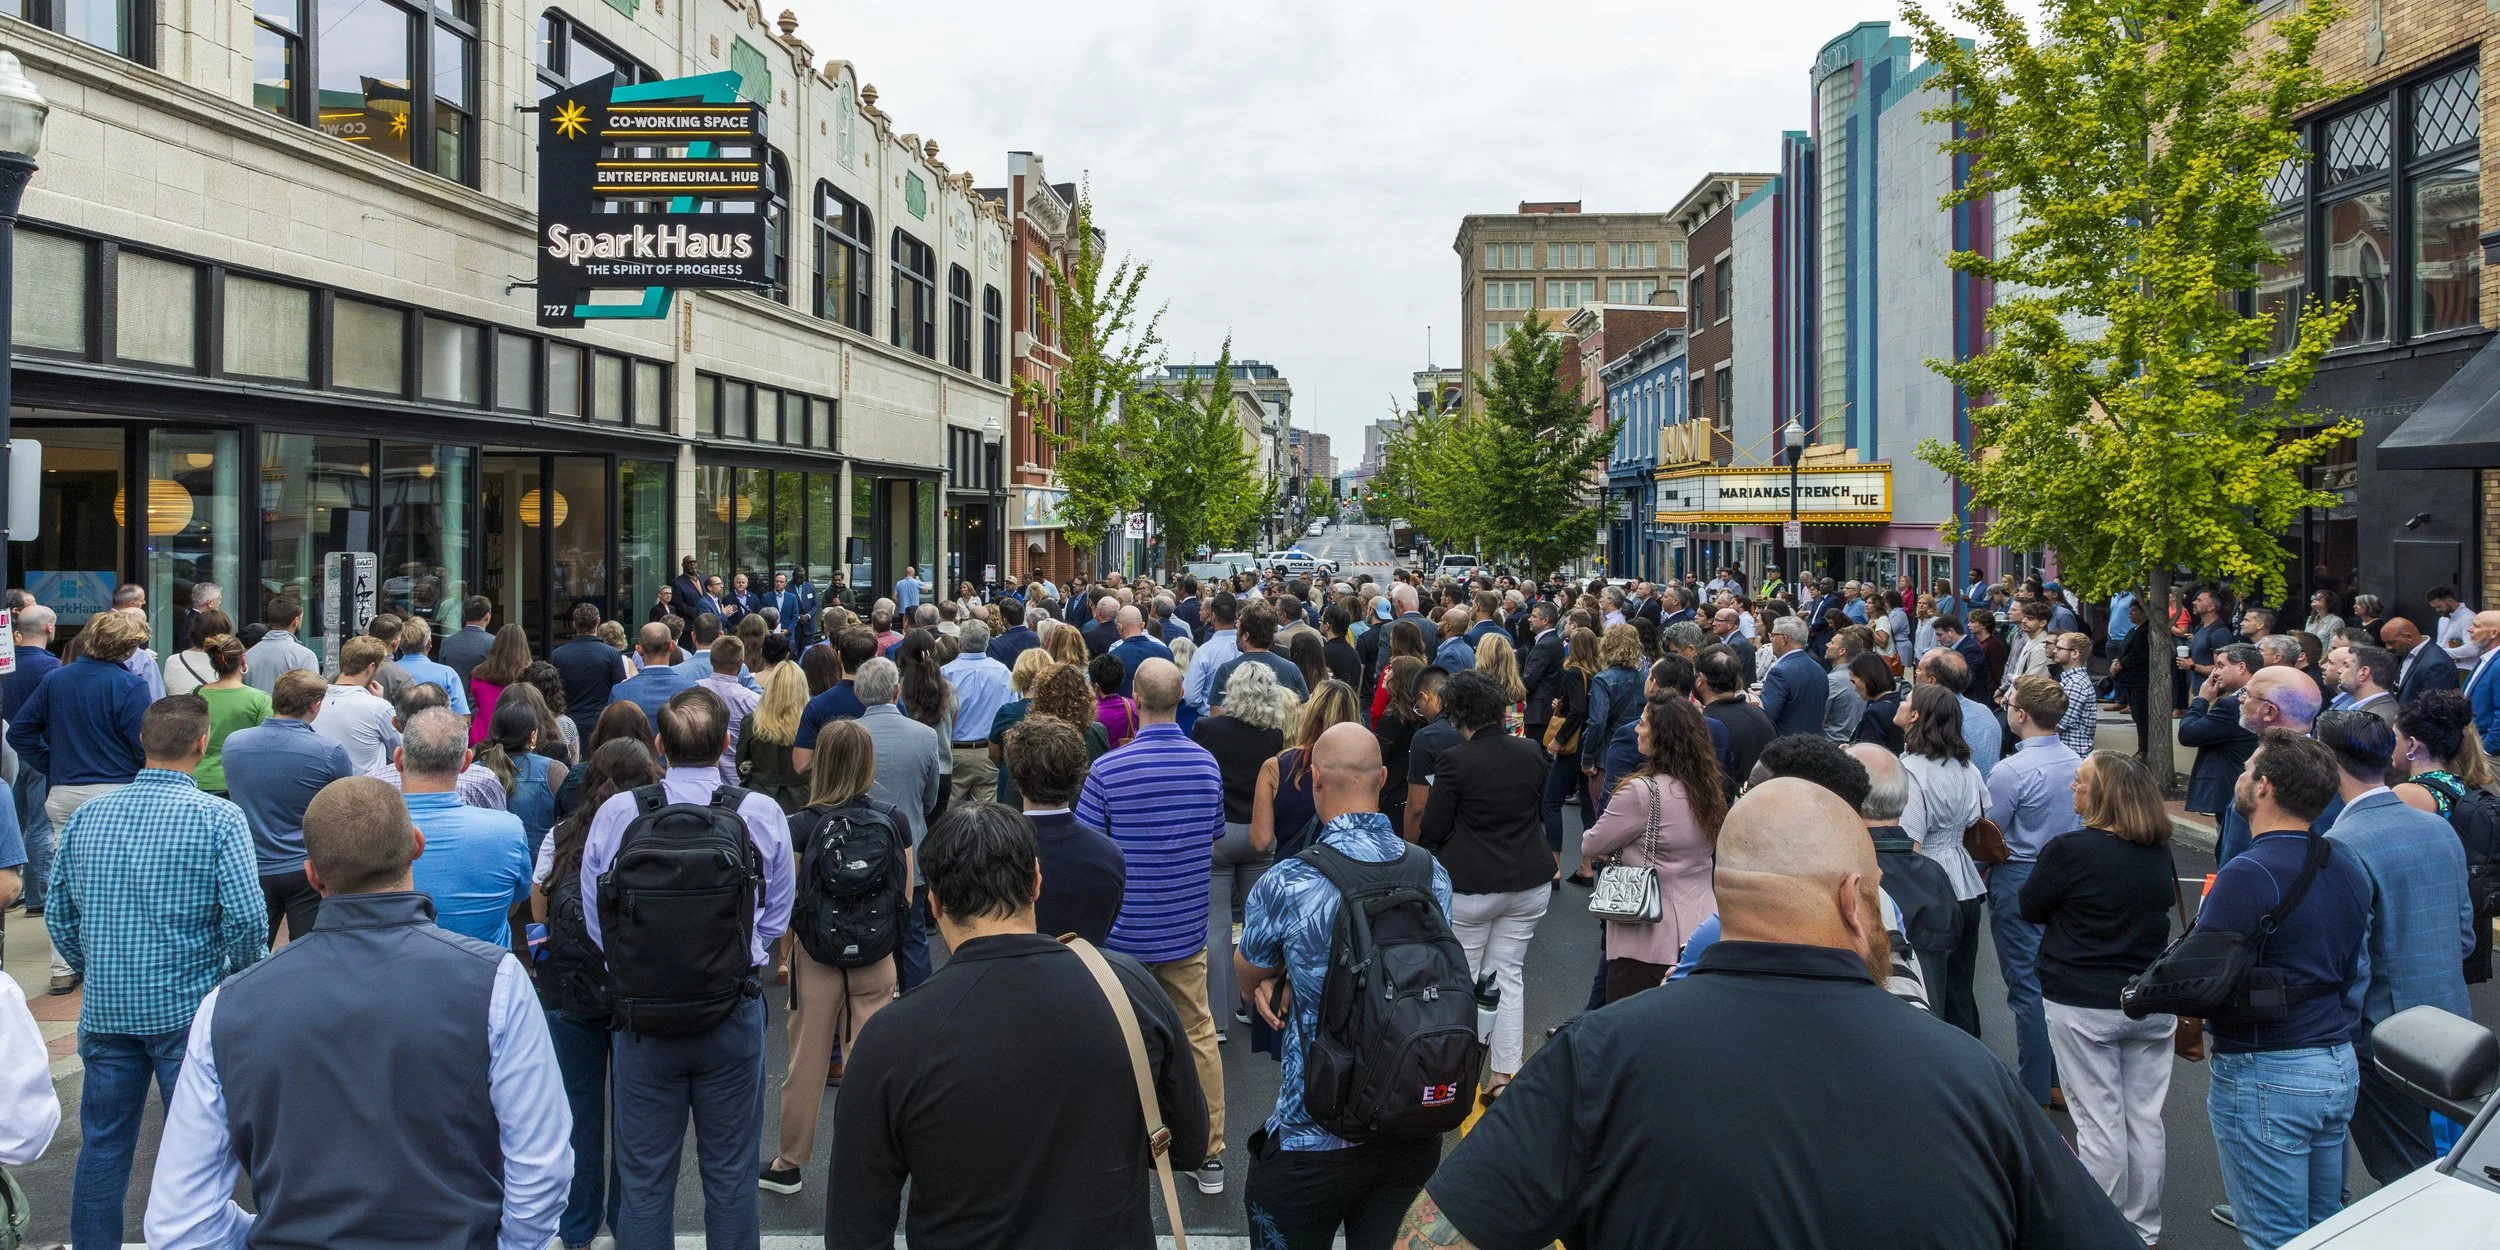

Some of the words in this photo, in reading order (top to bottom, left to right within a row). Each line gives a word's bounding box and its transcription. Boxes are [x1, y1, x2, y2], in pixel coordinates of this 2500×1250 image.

[609, 115, 701, 128] CO-WORKING
[703, 115, 749, 128] SPACE
[597, 171, 728, 183] ENTREPRENEURIAL
[731, 170, 760, 183] HUB
[548, 223, 753, 266] SparkHaus
[586, 264, 610, 275] THE
[612, 264, 653, 275] SPIRIT
[656, 264, 673, 275] OF
[675, 264, 743, 275] PROGRESS
[543, 304, 568, 316] 727
[1719, 486, 1790, 498] MARIANAS
[1796, 485, 1850, 498] TRENCH
[1852, 494, 1878, 505] TUE
[55, 602, 103, 614] arkHaus
[1423, 1082, 1457, 1100] EOS
